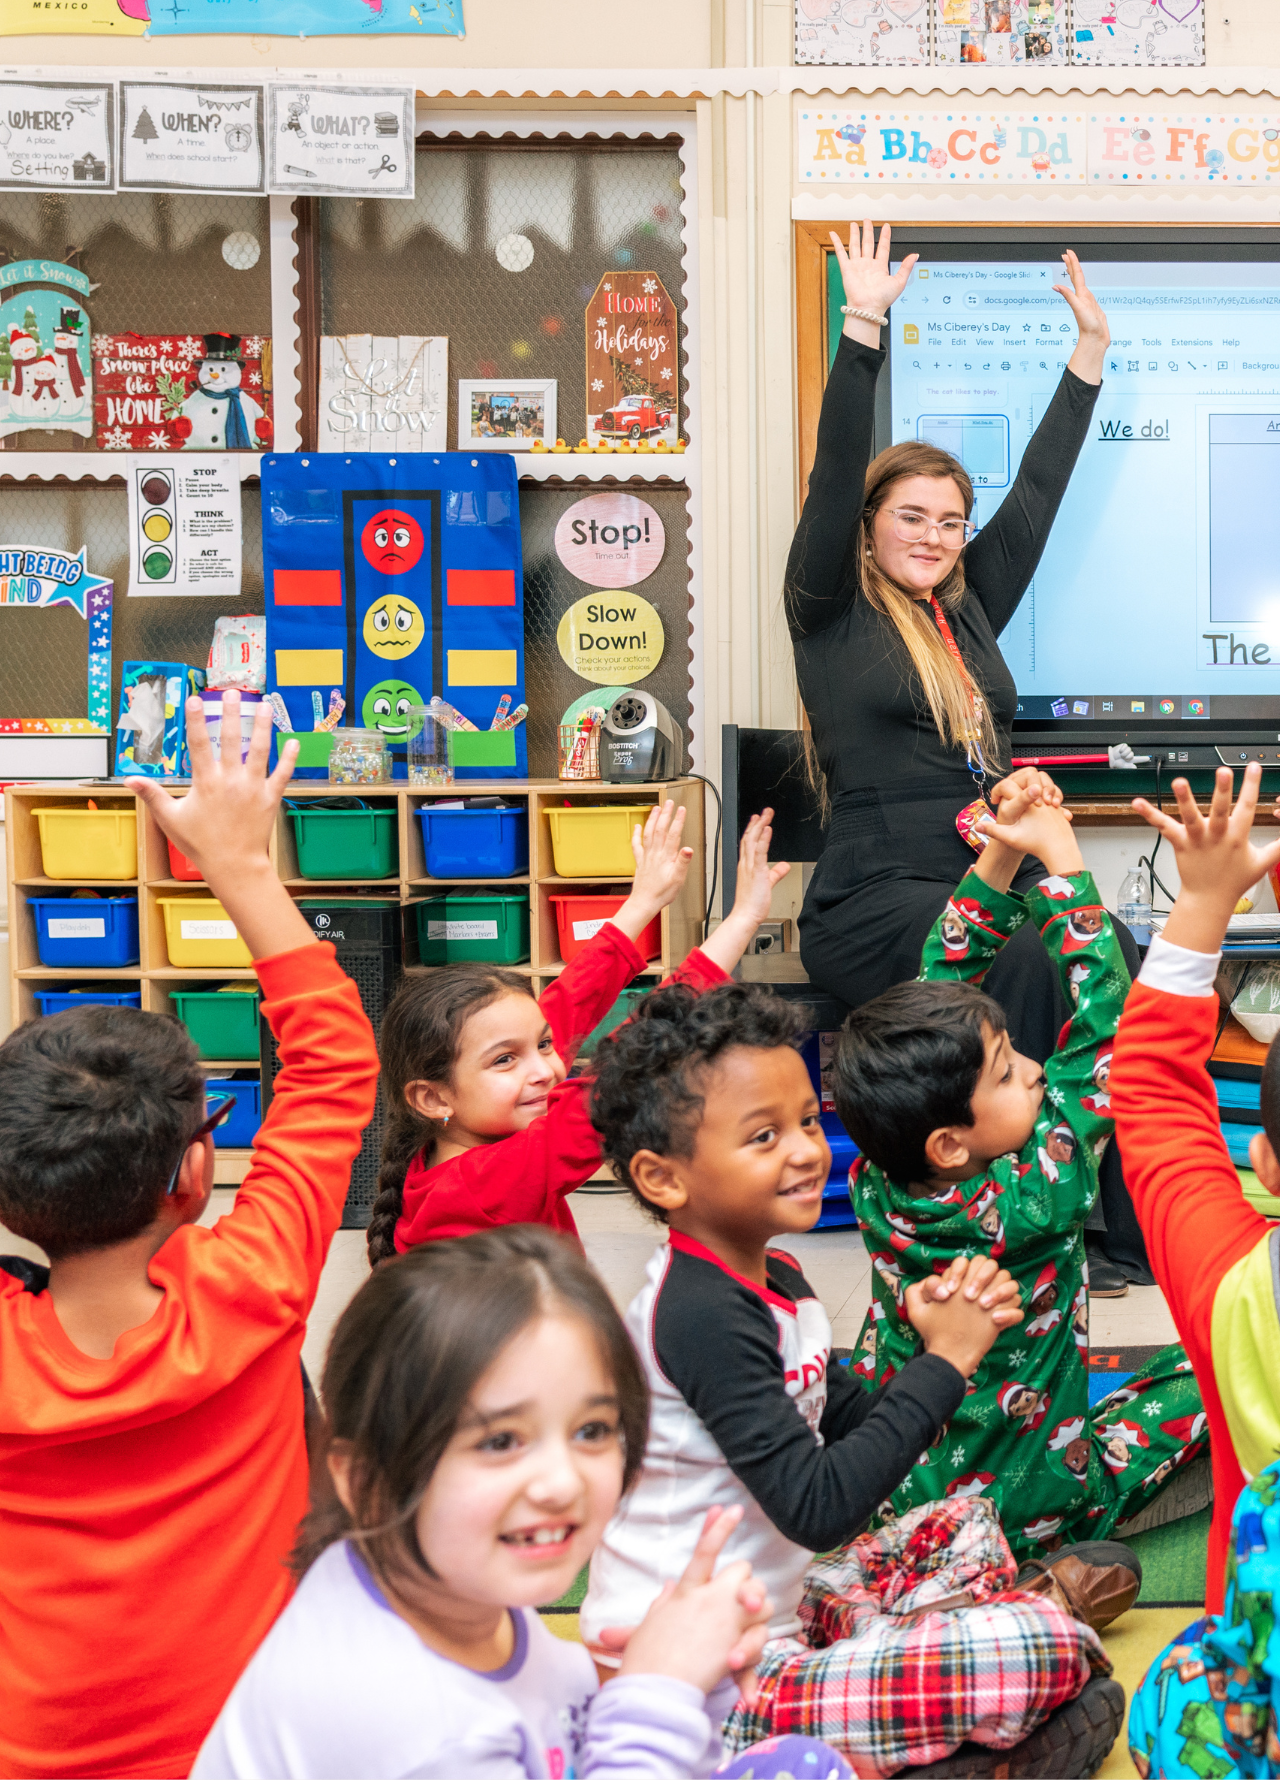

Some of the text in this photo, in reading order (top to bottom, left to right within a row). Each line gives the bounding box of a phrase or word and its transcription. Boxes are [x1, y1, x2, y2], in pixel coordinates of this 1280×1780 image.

[32, 2, 89, 11] MEXICO
[8, 109, 74, 131] WHERE?
[161, 111, 222, 134] WHEN?
[310, 115, 371, 137] WHAT?
[27, 136, 33, 144] A
[177, 138, 185, 146] A
[301, 140, 313, 149] An
[314, 141, 339, 151] object
[354, 142, 380, 151] action.
[7, 151, 75, 161] Where do you live?
[146, 152, 238, 163] When does school start?
[315, 155, 367, 165] What is that?
[10, 160, 70, 181] Setting
[0, 260, 77, 287] Let it Snow
[933, 270, 1017, 280] Ms Ciberey's Day Google
[603, 292, 662, 314] HOME
[627, 313, 674, 333] for the
[927, 321, 1011, 335] Ms Ciberey's Day
[114, 342, 159, 359] There's
[593, 324, 670, 361] Holidays
[928, 337, 1241, 348] File Edit View Insert Format Tools Extensions Help
[151, 356, 194, 378] place
[125, 375, 153, 395] like
[343, 357, 419, 398] Let
[106, 396, 167, 427] HOME
[327, 393, 442, 434] Snow
[1100, 419, 1170, 438] We do!
[192, 468, 218, 476] STOP
[194, 510, 225, 518] THINK
[571, 517, 651, 550] Stop!
[200, 549, 219, 557] ACT
[595, 552, 614, 560] Time
[586, 604, 637, 624] Slow
[578, 631, 648, 651] Down!
[1202, 632, 1272, 665] The
[575, 656, 603, 665] Check
[604, 657, 622, 667] your
[612, 666, 627, 674] your
[608, 742, 640, 750] BOSTITCH
